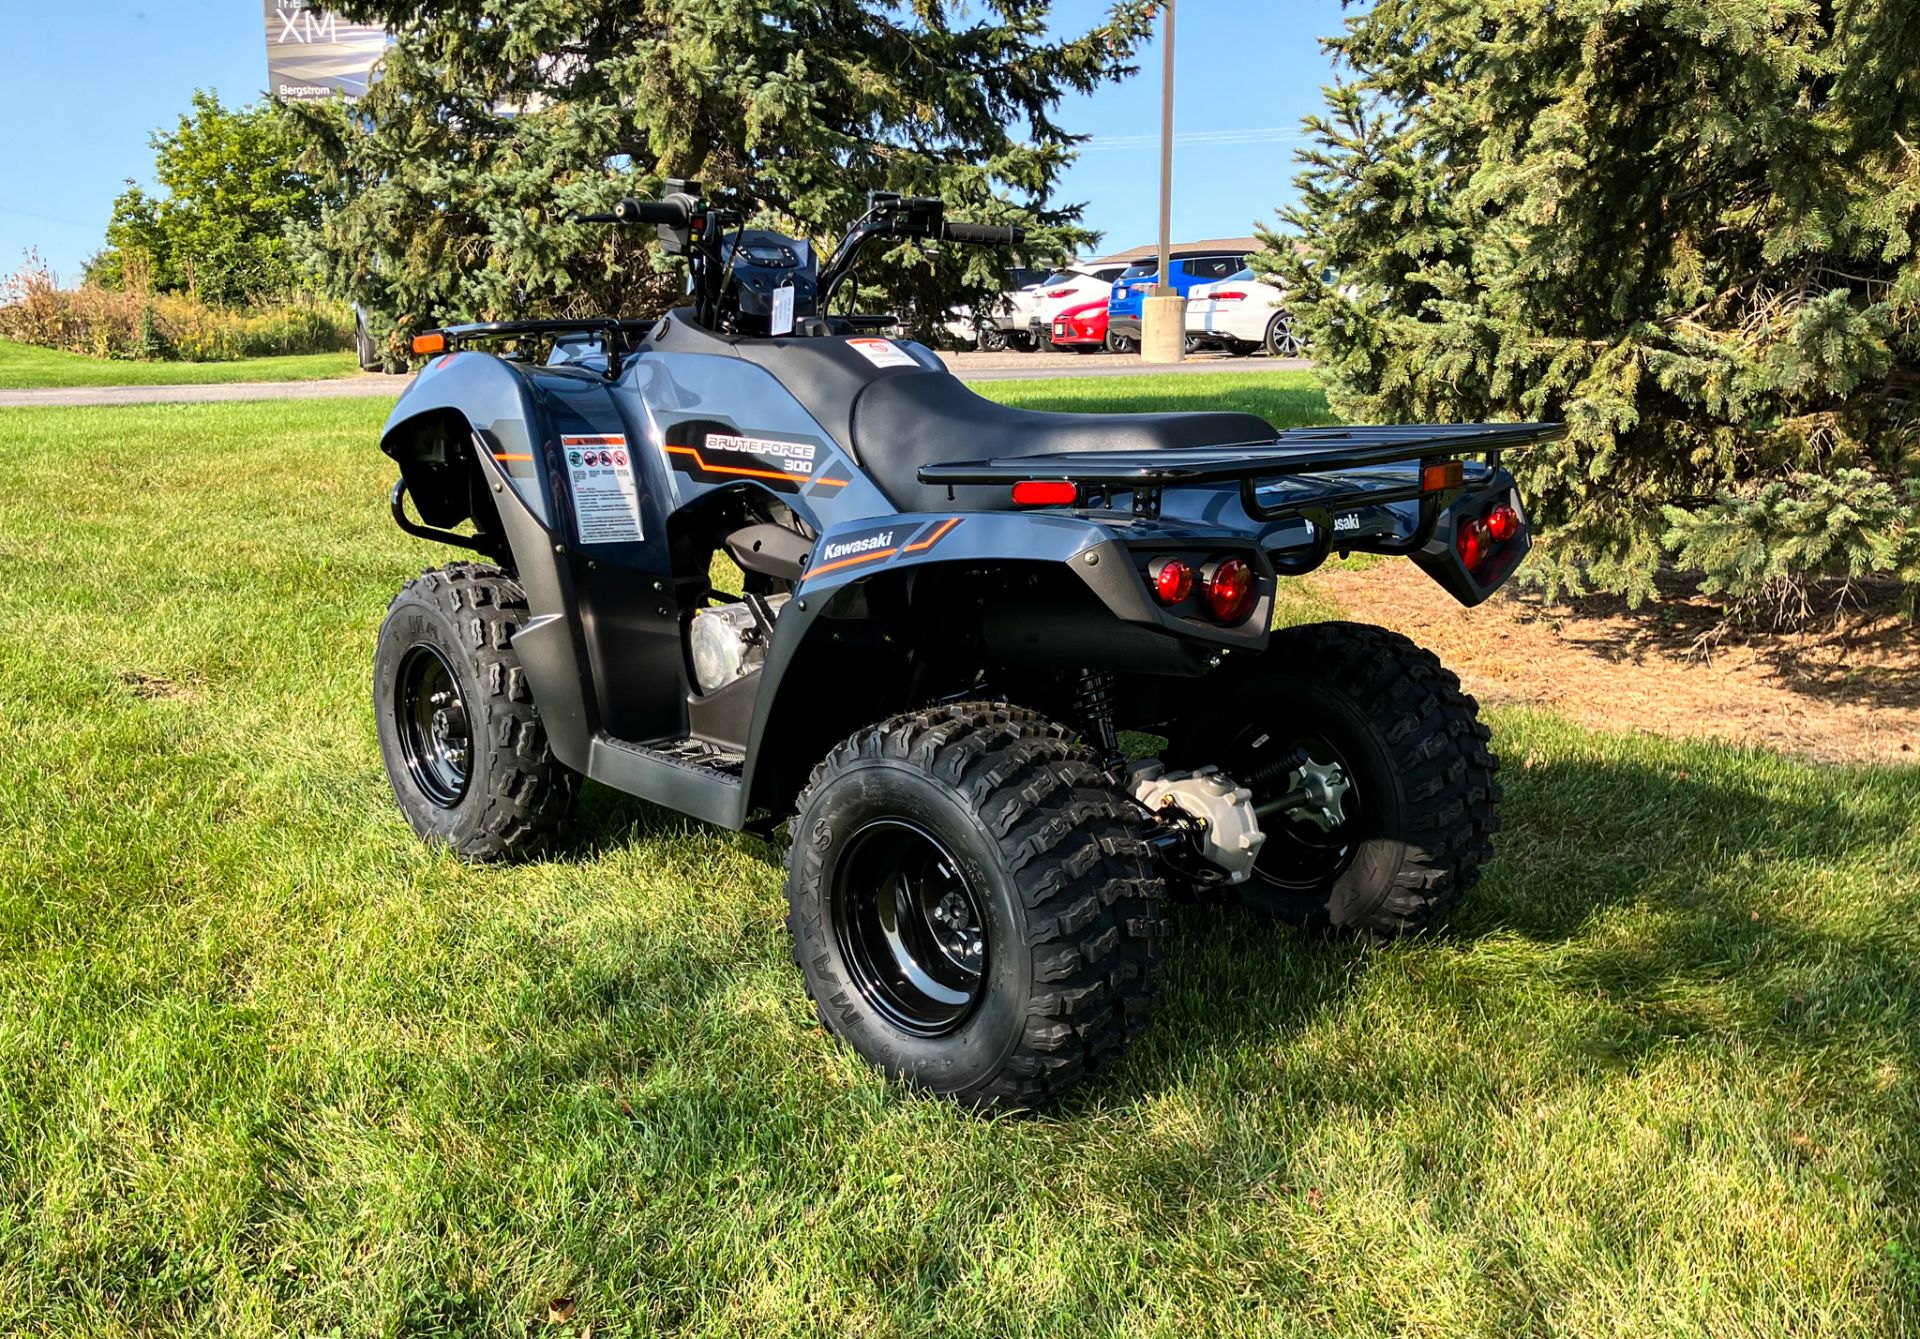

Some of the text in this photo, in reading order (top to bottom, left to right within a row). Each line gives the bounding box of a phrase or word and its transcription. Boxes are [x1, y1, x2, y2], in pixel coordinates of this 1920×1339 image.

[276, 9, 336, 43] XM
[279, 85, 330, 96] Bergstrom
[784, 459, 812, 473] 300
[824, 531, 894, 561] Kawasaki
[801, 817, 864, 1027] MAXXIS
